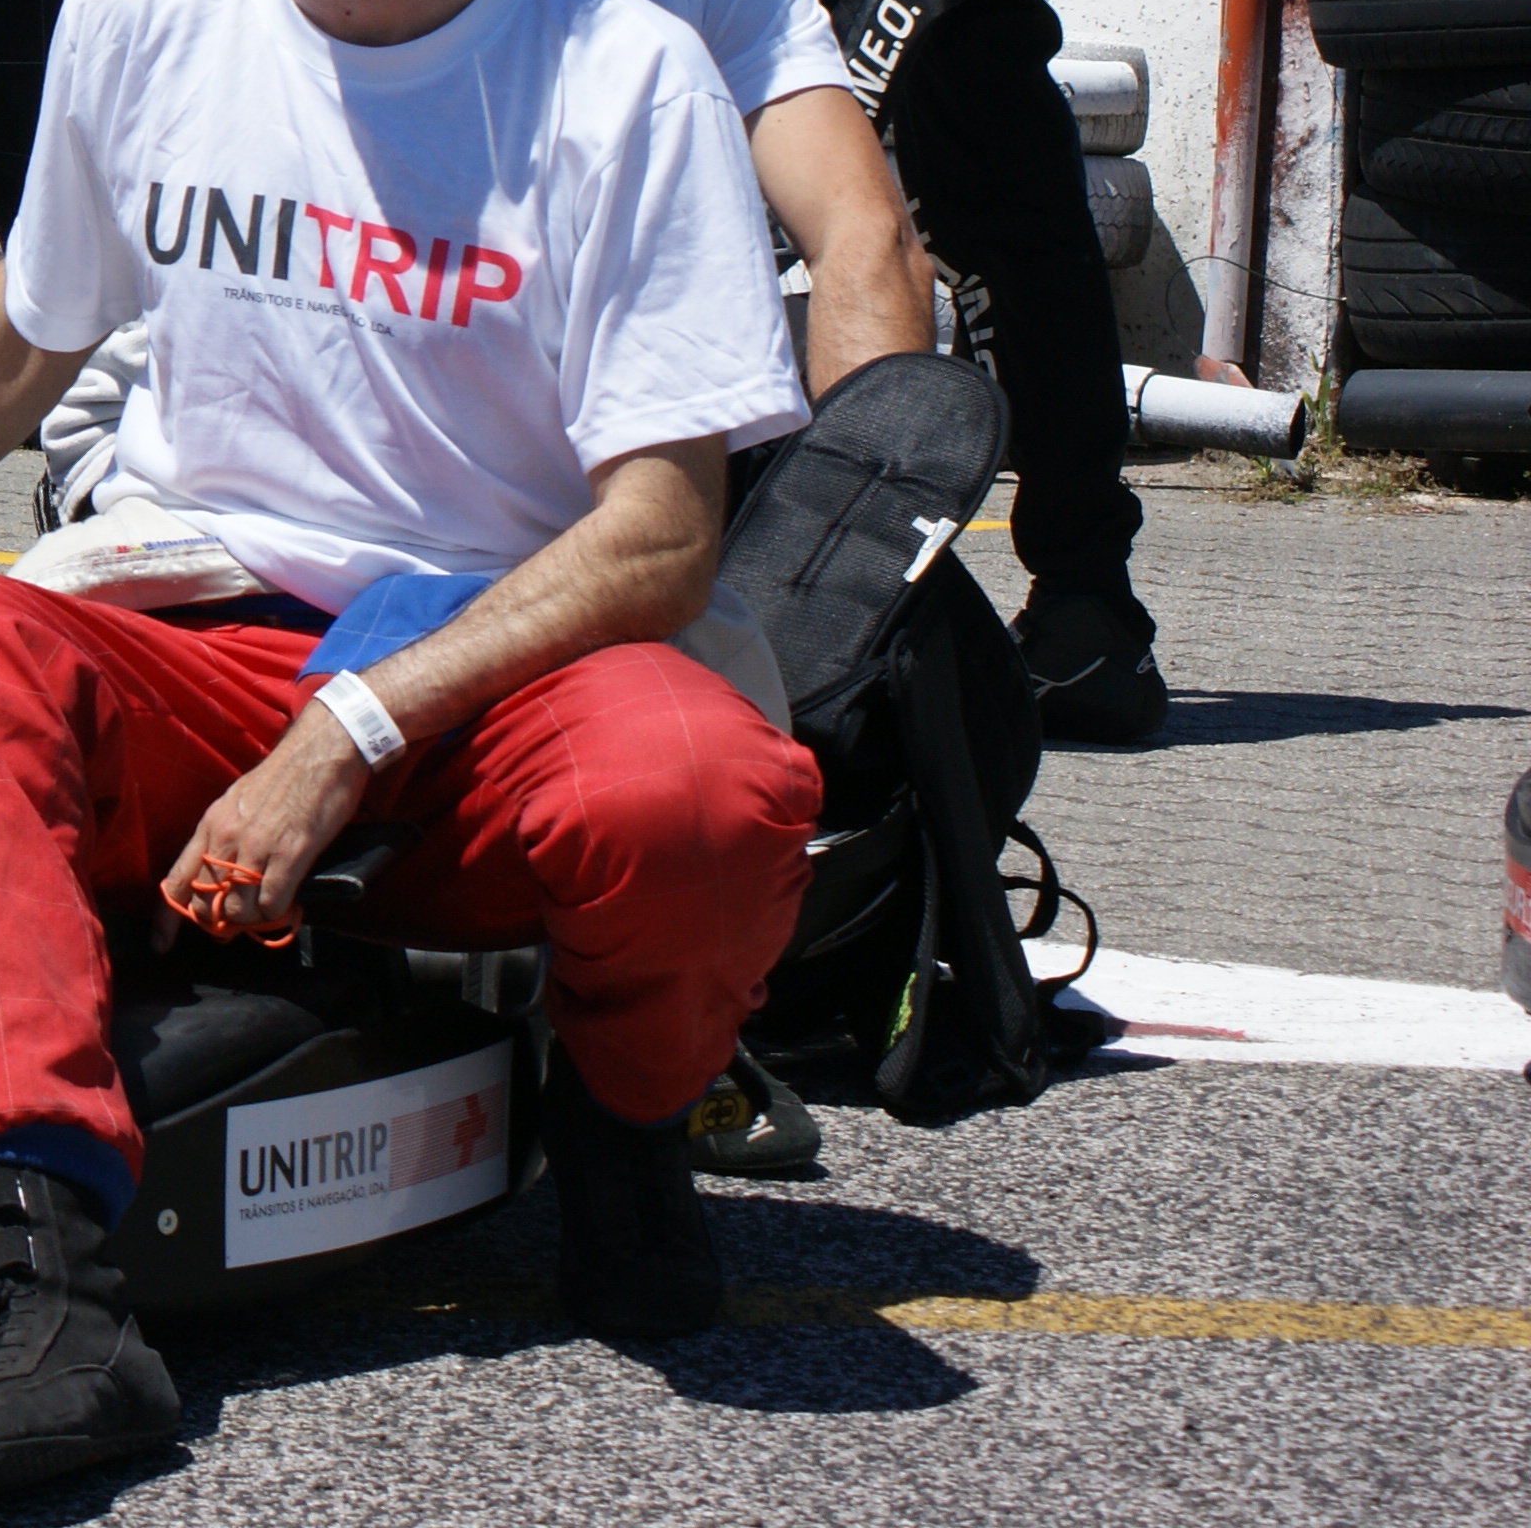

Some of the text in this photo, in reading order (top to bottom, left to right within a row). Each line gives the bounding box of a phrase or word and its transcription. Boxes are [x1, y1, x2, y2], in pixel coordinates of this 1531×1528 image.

[144, 181, 523, 328] UNITRIP
[222, 286, 293, 309] TRÂNSITOS
[295, 298, 304, 310] E
[239, 1121, 388, 1197] UNITRIP
[239, 1200, 296, 1221] TRÂNSITOS
[298, 1198, 304, 1211] E
